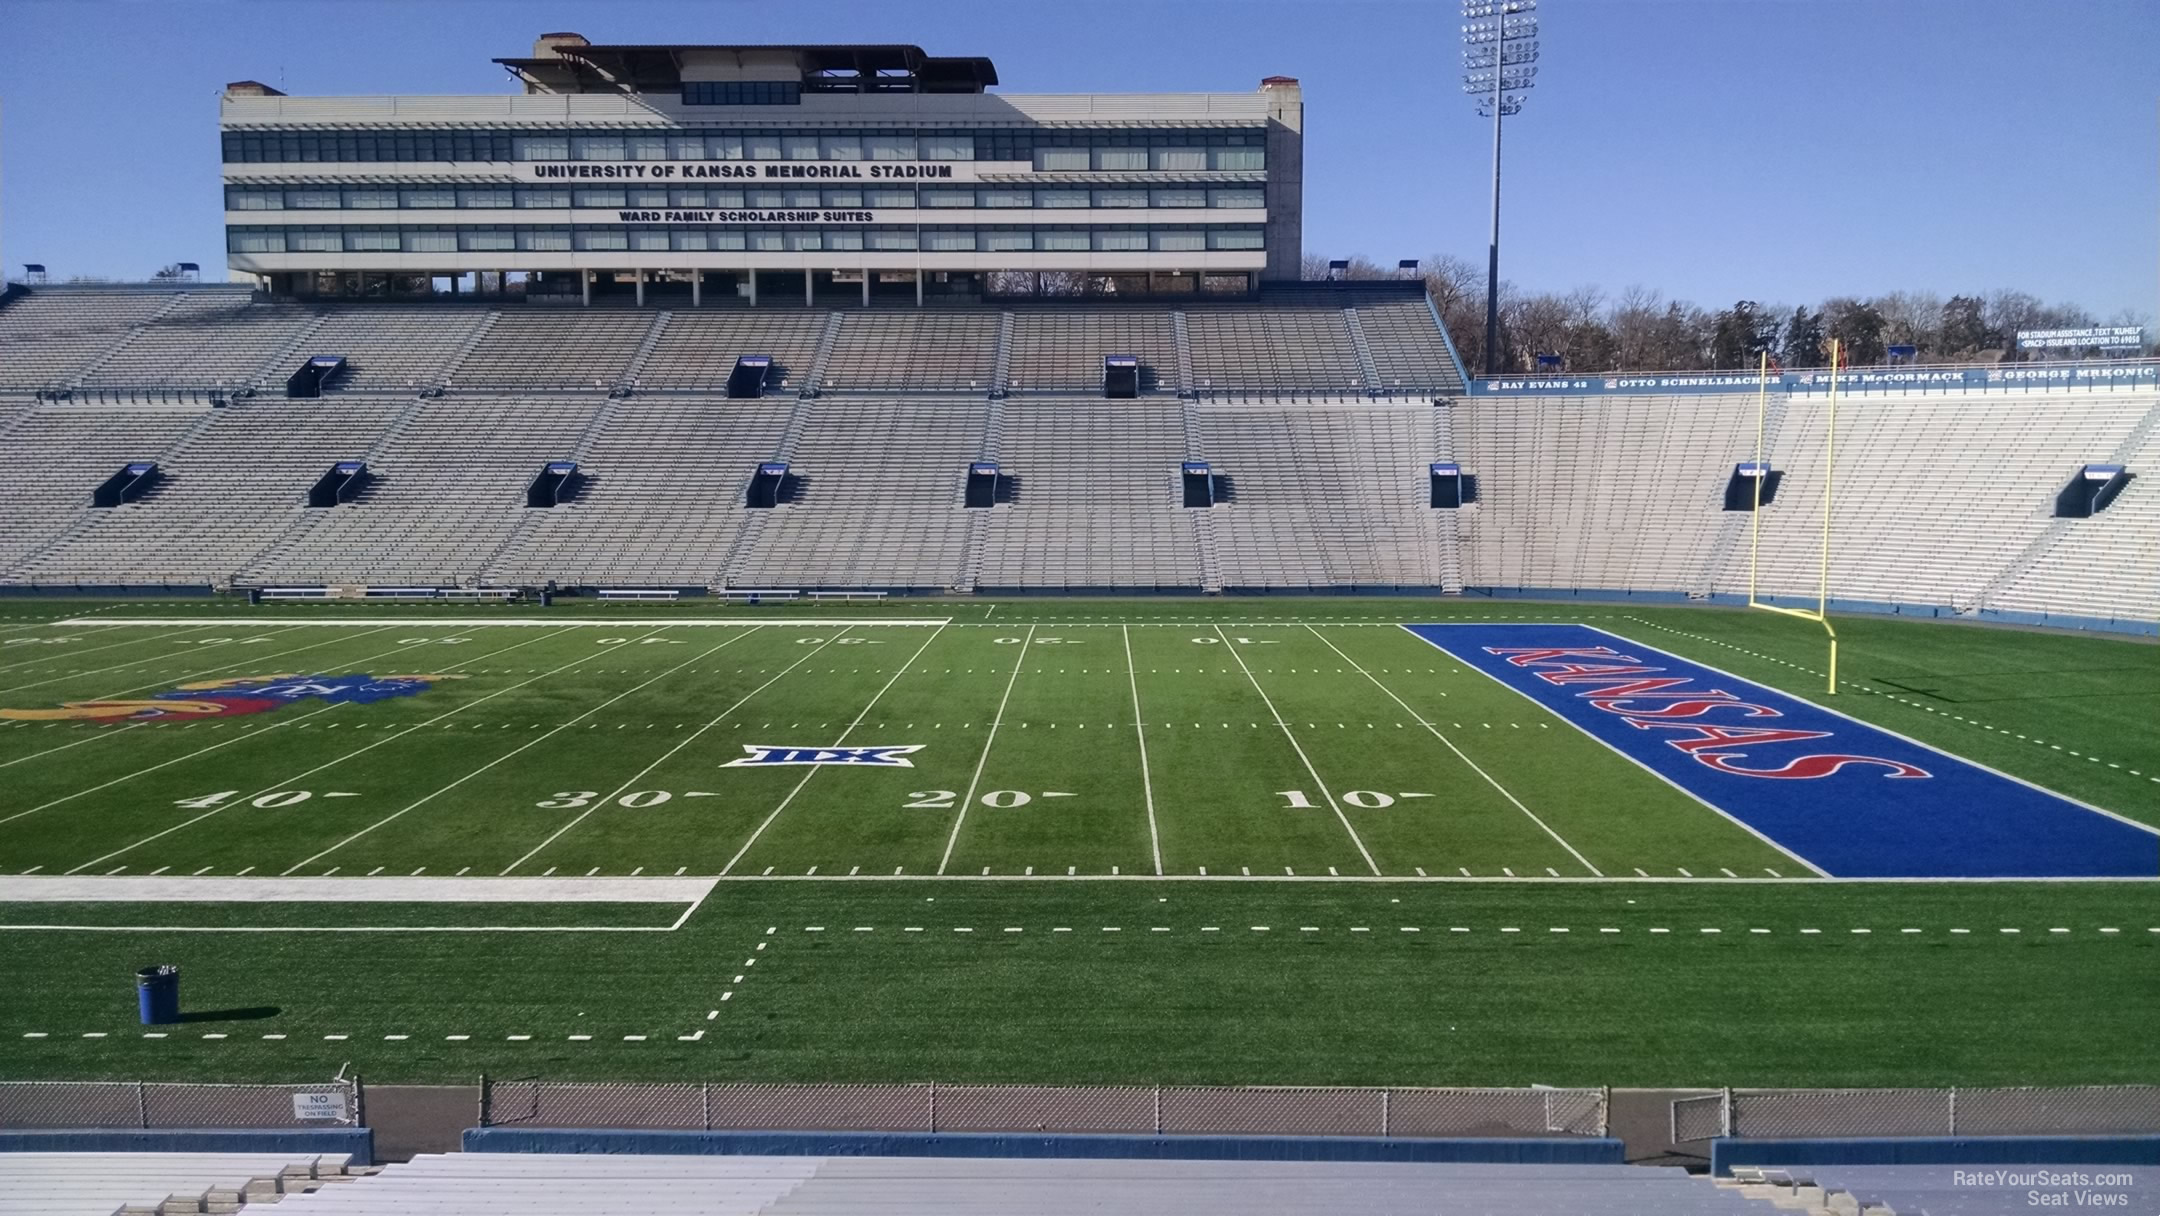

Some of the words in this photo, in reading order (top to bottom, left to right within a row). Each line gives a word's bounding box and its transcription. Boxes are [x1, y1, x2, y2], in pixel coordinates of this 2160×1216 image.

[534, 165, 646, 178] UNIVERSITY
[651, 165, 675, 178] OF
[682, 165, 756, 178] KANSAS
[765, 165, 862, 178] MEMORIAL
[870, 165, 952, 178] STADIUM
[619, 211, 661, 222] WARD
[665, 211, 714, 222] FAMILY
[719, 211, 820, 222] SCHOLARSHIP
[823, 211, 873, 222] SUITES
[2017, 331, 2030, 340] FOR
[2030, 330, 2057, 339] STADIUM
[2095, 328, 2110, 336] TEXT
[2046, 338, 2063, 347] ISSUE
[2062, 337, 2077, 346] AND
[2078, 336, 2110, 346] LOCATION
[2111, 336, 2119, 345] TO
[1816, 374, 1858, 383] MIKE
[2005, 369, 2070, 380] GEORGE
[2076, 367, 2154, 379] MRKONIC
[1501, 381, 1524, 389] RAY
[1529, 380, 1569, 389] EVANS
[1573, 380, 1588, 389] 42
[1619, 379, 1656, 387] OTTO
[1660, 376, 1781, 387] SCHNELLBACHER
[1482, 646, 1934, 779] KANSAS
[173, 790, 312, 808] 40
[535, 790, 673, 808] 30
[902, 790, 1032, 808] 20
[1274, 790, 1395, 808] 10
[310, 1095, 328, 1103] NO
